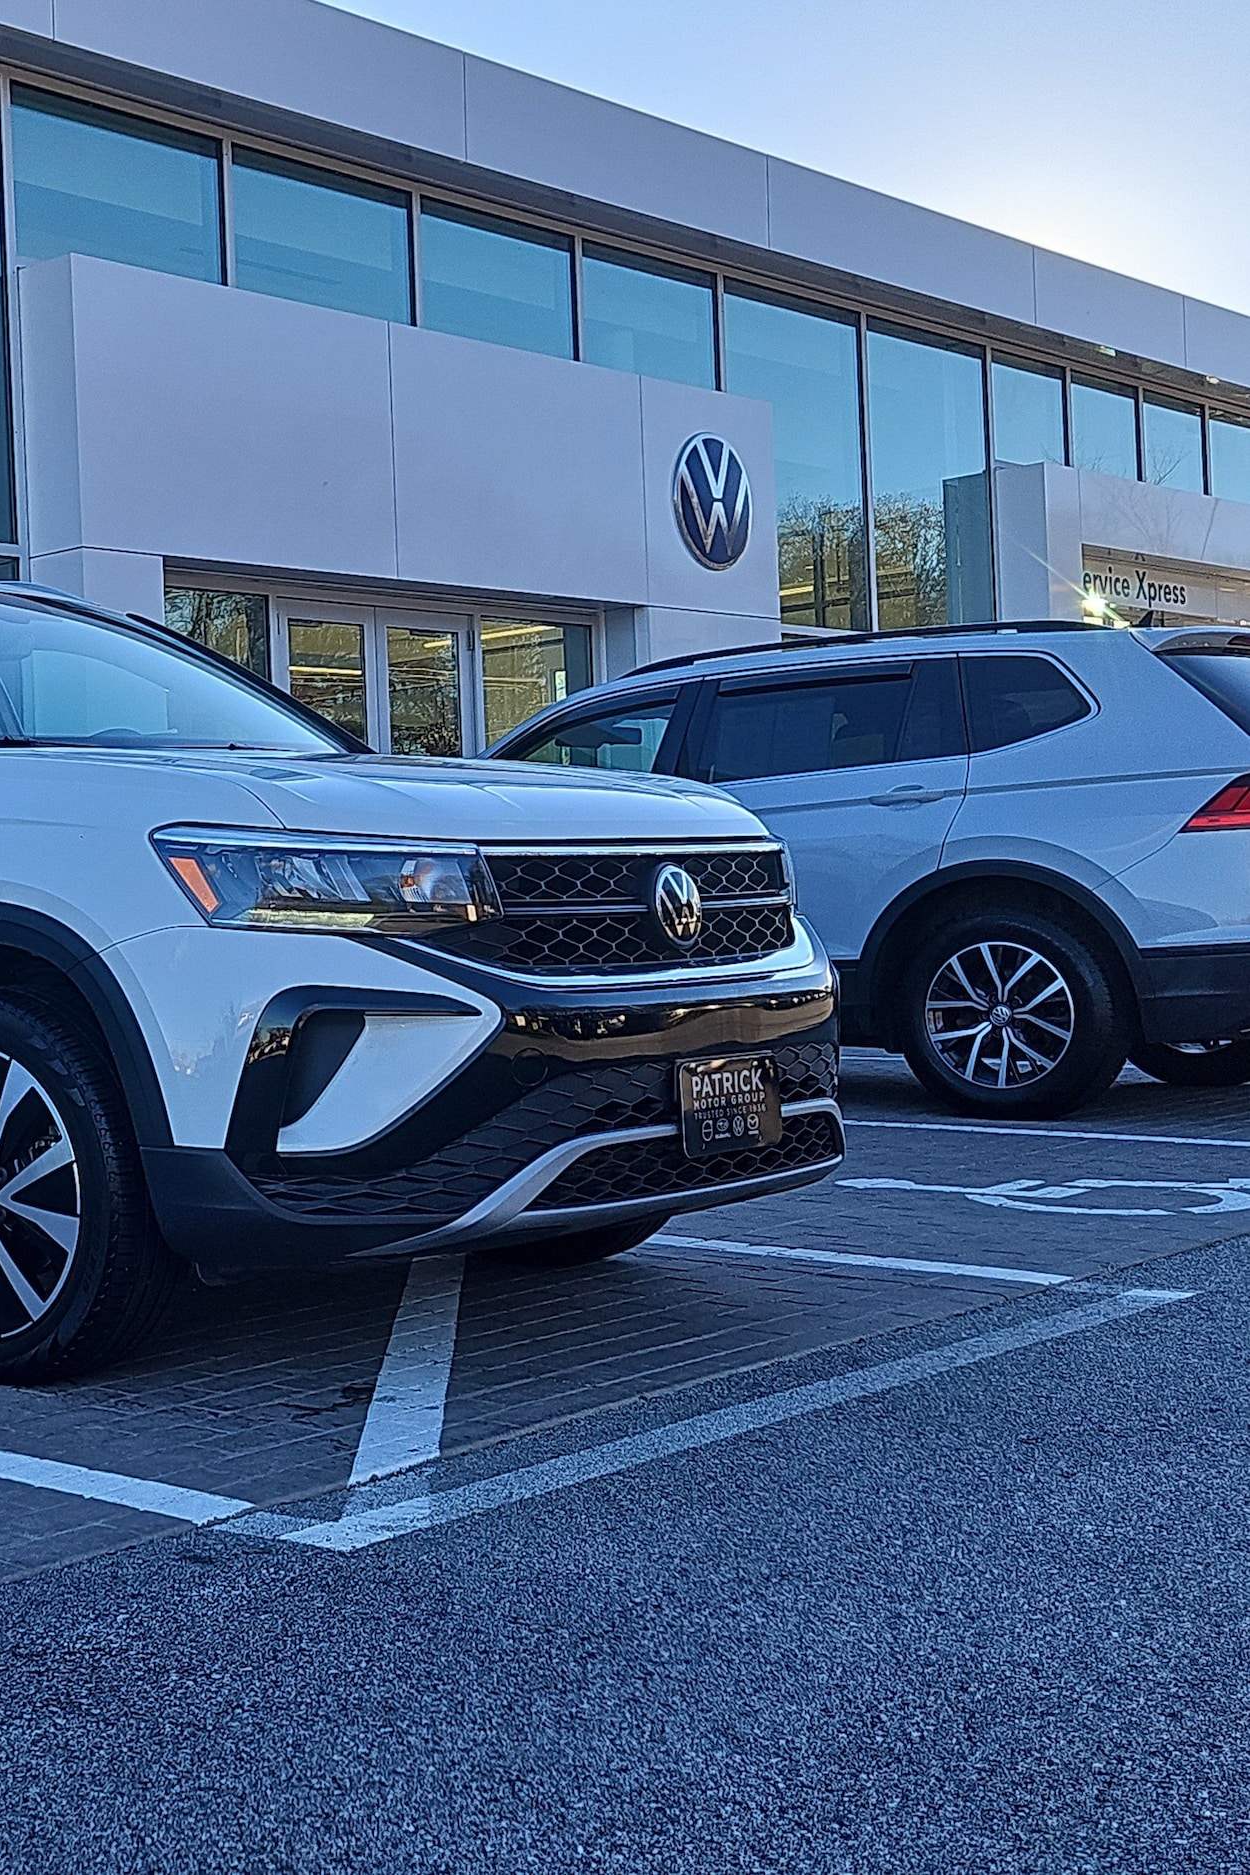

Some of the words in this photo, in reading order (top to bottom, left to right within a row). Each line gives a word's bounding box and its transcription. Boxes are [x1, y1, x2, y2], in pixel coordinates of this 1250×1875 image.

[1083, 566, 1130, 598] ervice
[1135, 570, 1186, 607] Xpress
[692, 1067, 765, 1098] PATRICK
[693, 1096, 726, 1111] MOTOR
[730, 1092, 765, 1105] GROUP
[694, 1108, 724, 1120] TRUSTED
[726, 1105, 747, 1116] SINCE
